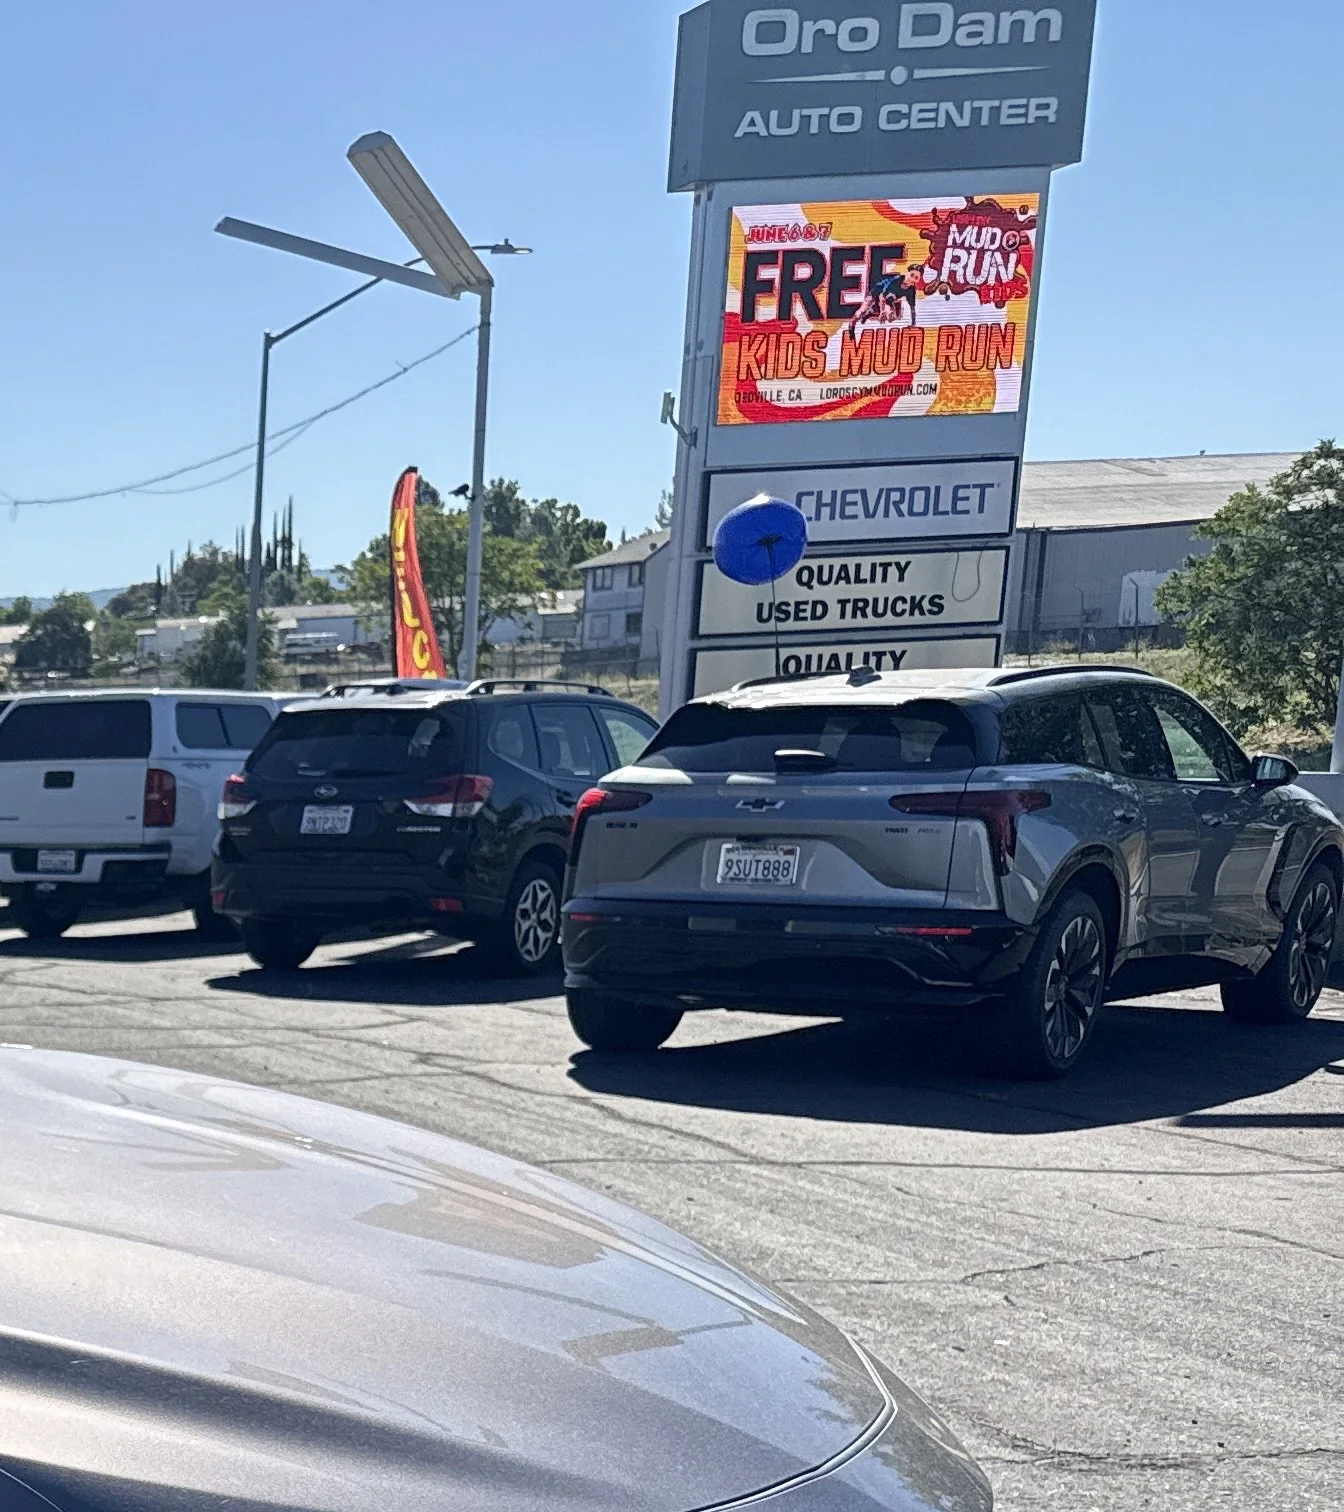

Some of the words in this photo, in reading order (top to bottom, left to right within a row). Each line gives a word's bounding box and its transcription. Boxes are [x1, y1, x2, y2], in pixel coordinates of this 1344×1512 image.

[742, 8, 880, 57] Oro
[898, 2, 1064, 49] Dam
[733, 105, 864, 138] AUTO
[878, 96, 1060, 131] CENTER
[947, 223, 1003, 250] MUD
[940, 247, 1018, 285] RUN
[735, 330, 829, 382] KIDS
[838, 324, 926, 378] MUD
[934, 321, 1016, 373] RUN
[787, 389, 803, 401] CA
[796, 482, 995, 522] CHEVROLET
[795, 560, 912, 589] QUALITY
[756, 599, 830, 624] USED
[837, 594, 945, 619] TRUCKS
[723, 858, 792, 878] 9SUT888
